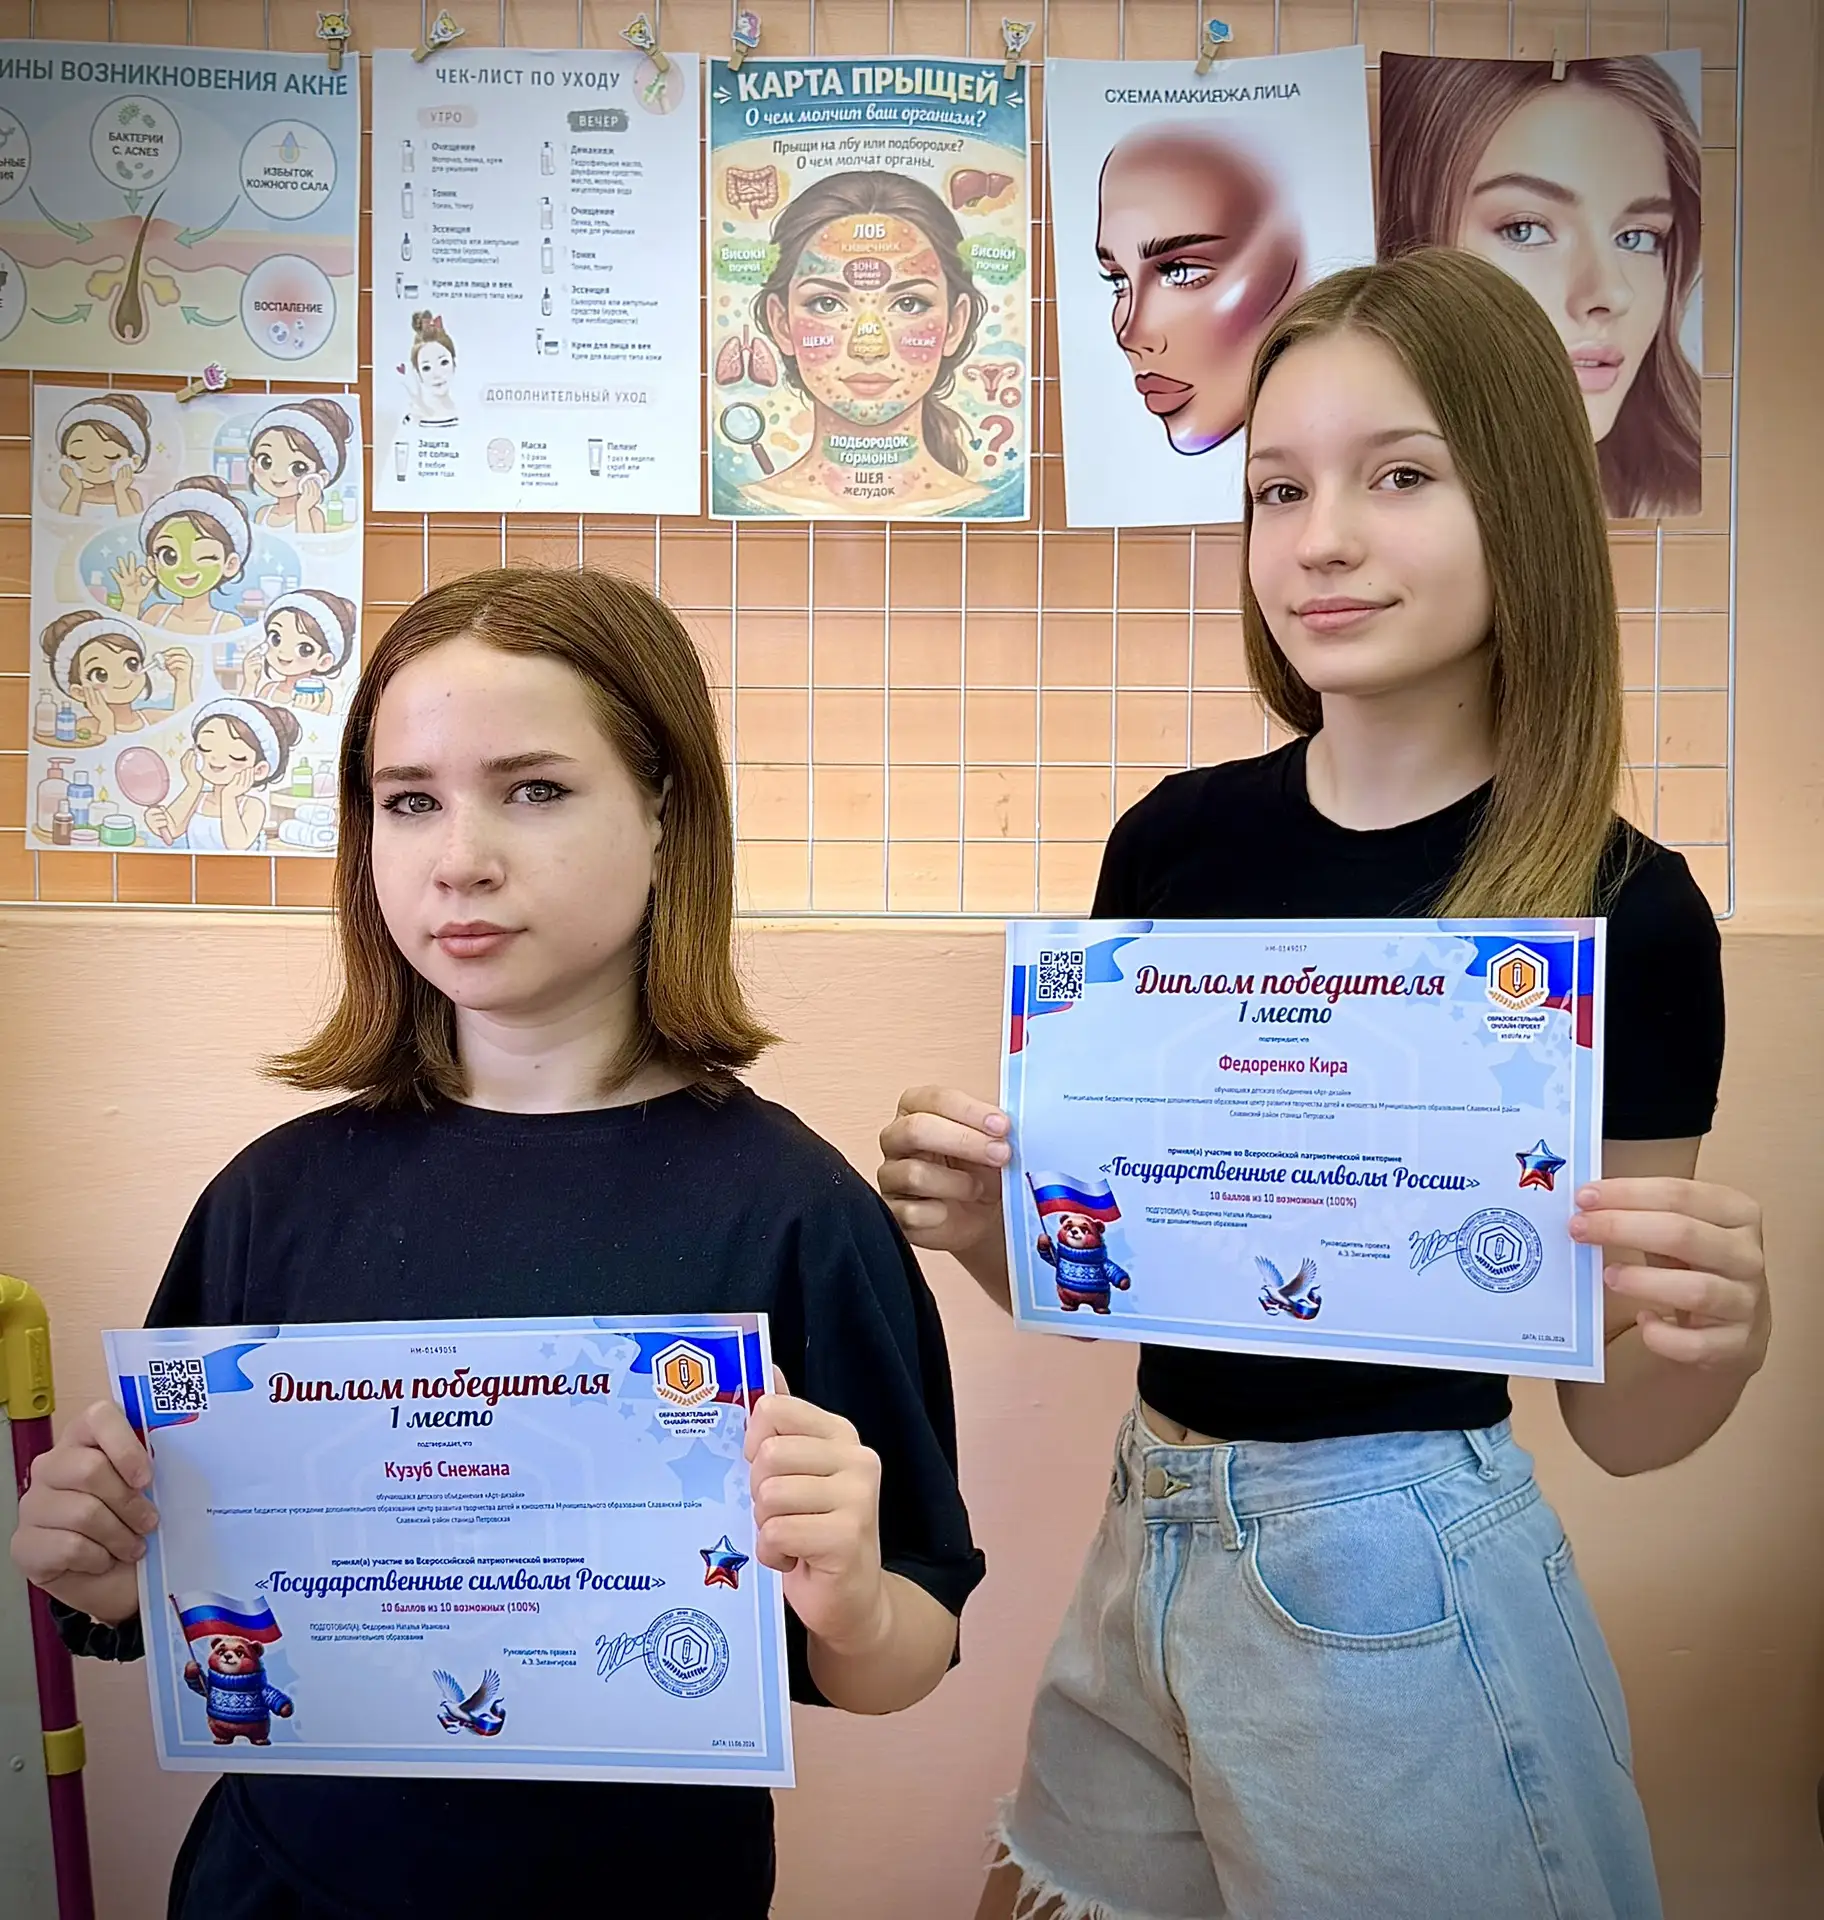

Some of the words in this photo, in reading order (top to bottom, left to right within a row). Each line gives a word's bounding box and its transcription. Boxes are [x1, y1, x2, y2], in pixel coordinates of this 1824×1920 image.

[61, 61, 277, 92] ВОЗНИКНОВЕНИЯ
[284, 74, 348, 96] АКНЕ
[435, 68, 524, 86] ЧЕК-ЛИСТ
[531, 71, 555, 86] ПО
[562, 72, 621, 91] УХОДУ
[738, 68, 843, 102] КАРТА
[852, 67, 998, 106] ПРЫЩЕЙ
[1104, 88, 1162, 104] СХЕМА
[1164, 88, 1251, 104] МАКИЯЖА
[1252, 83, 1301, 101] ЛИЦА
[430, 111, 463, 124] УТРО
[579, 114, 619, 128] ВЕЧЕР
[745, 108, 759, 127] О
[763, 111, 795, 125] чем
[797, 109, 862, 124] молчит
[866, 102, 899, 121] ваш
[901, 109, 987, 127] организм?
[108, 132, 164, 145] БАКТЕРИИ
[773, 140, 818, 154] Прыщи
[821, 141, 836, 151] на
[838, 137, 861, 154] лбу
[863, 139, 886, 150] или
[888, 138, 964, 154] подбородке?
[124, 146, 160, 158] ACNES
[796, 156, 806, 169] О
[809, 158, 833, 168] чем
[836, 155, 881, 167] молчат
[884, 155, 935, 169] органы.
[263, 166, 314, 179] ИЗБЫТОК
[246, 179, 299, 192] КОЖНОГО
[300, 181, 330, 192] САЛА
[852, 223, 887, 240] ЛОБ
[254, 301, 323, 314] ВОСПАЛЕНИЕ
[486, 388, 610, 403] ДОПОЛНИТЕЛЬНЫЙ
[615, 391, 647, 404] УХОД
[418, 440, 450, 449] Защита
[521, 441, 547, 450] Маска
[829, 434, 909, 450] ПОДБОРОДОК
[839, 451, 899, 467] гормоны
[855, 472, 884, 485] ШЕЯ
[843, 485, 896, 499] желудок
[1135, 965, 1254, 995] Диплом
[1261, 965, 1445, 1004] победителя
[1238, 1001, 1249, 1023] 1
[1252, 1004, 1332, 1024] место
[1219, 1055, 1305, 1075] Федоренко
[1310, 1057, 1348, 1077] Кира
[1168, 1148, 1202, 1158] принял(а)
[1204, 1149, 1232, 1159] участие
[1244, 1149, 1299, 1160] Всероссийской
[1301, 1152, 1360, 1162] патриотической
[1362, 1155, 1402, 1163] викторине
[1099, 1156, 1287, 1185] «Государственные
[1291, 1164, 1388, 1188] символы
[1393, 1167, 1480, 1191] России»
[1210, 1191, 1220, 1201] 10
[1222, 1191, 1251, 1203] баллов
[1252, 1195, 1262, 1203] из
[1264, 1193, 1274, 1203] 10
[1276, 1195, 1324, 1206] возможных
[1326, 1196, 1357, 1208] (100%)
[268, 1372, 405, 1404] Диплом
[411, 1366, 611, 1407] победителя
[391, 1406, 400, 1429] 1
[406, 1408, 493, 1429] место
[385, 1461, 433, 1482] Кузуб
[437, 1460, 510, 1478] Снежана
[331, 1558, 370, 1567] принял(а)
[372, 1558, 402, 1567] участие
[416, 1556, 475, 1566] Всероссийской
[477, 1555, 541, 1565] патриотической
[543, 1555, 585, 1564] викторине
[254, 1570, 462, 1598] «Государственные
[468, 1568, 571, 1591] символы
[576, 1567, 666, 1591] России»
[381, 1602, 392, 1613] 10
[394, 1602, 426, 1613] баллов
[428, 1604, 438, 1613] из
[440, 1602, 451, 1613] 10
[454, 1602, 505, 1612] возможных
[507, 1601, 540, 1613] (100%)
